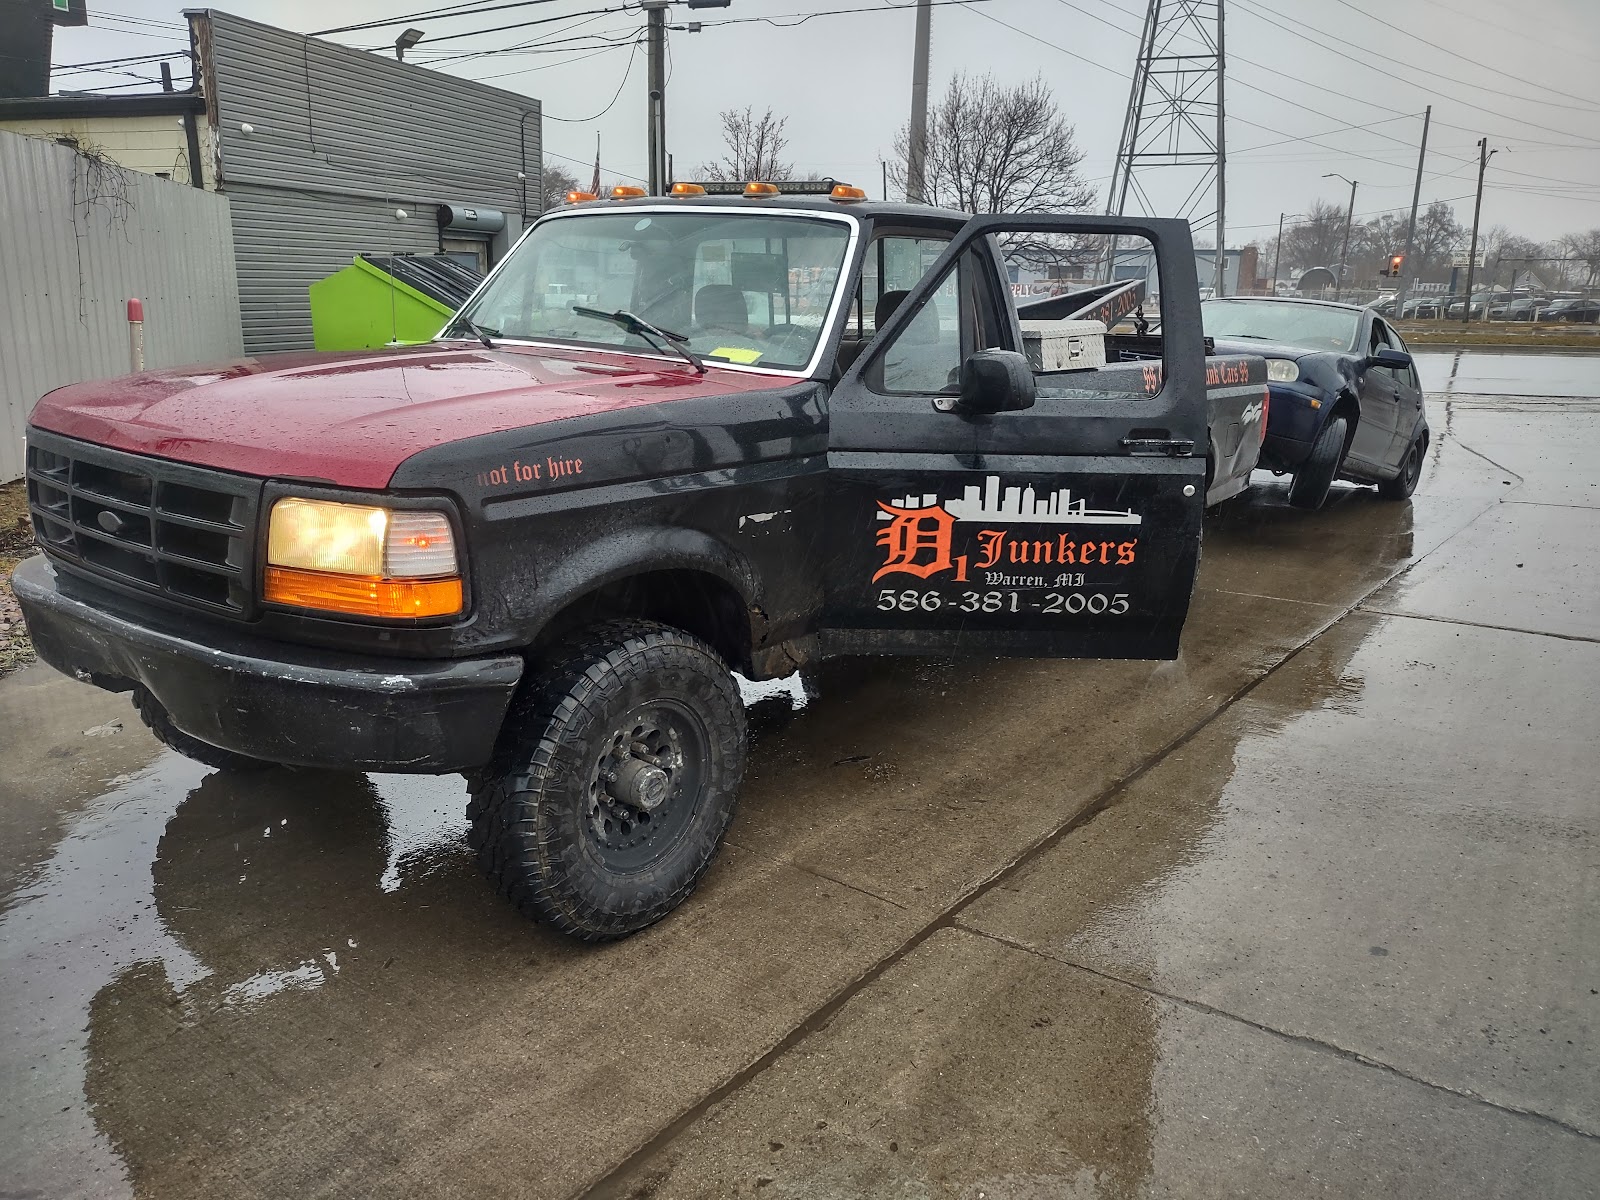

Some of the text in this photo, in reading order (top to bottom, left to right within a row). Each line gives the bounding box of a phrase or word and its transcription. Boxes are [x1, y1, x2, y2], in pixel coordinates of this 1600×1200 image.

[513, 459, 542, 482] for
[546, 455, 584, 482] hire
[973, 529, 1138, 569] Junkers
[984, 571, 1086, 588] Warren, MI
